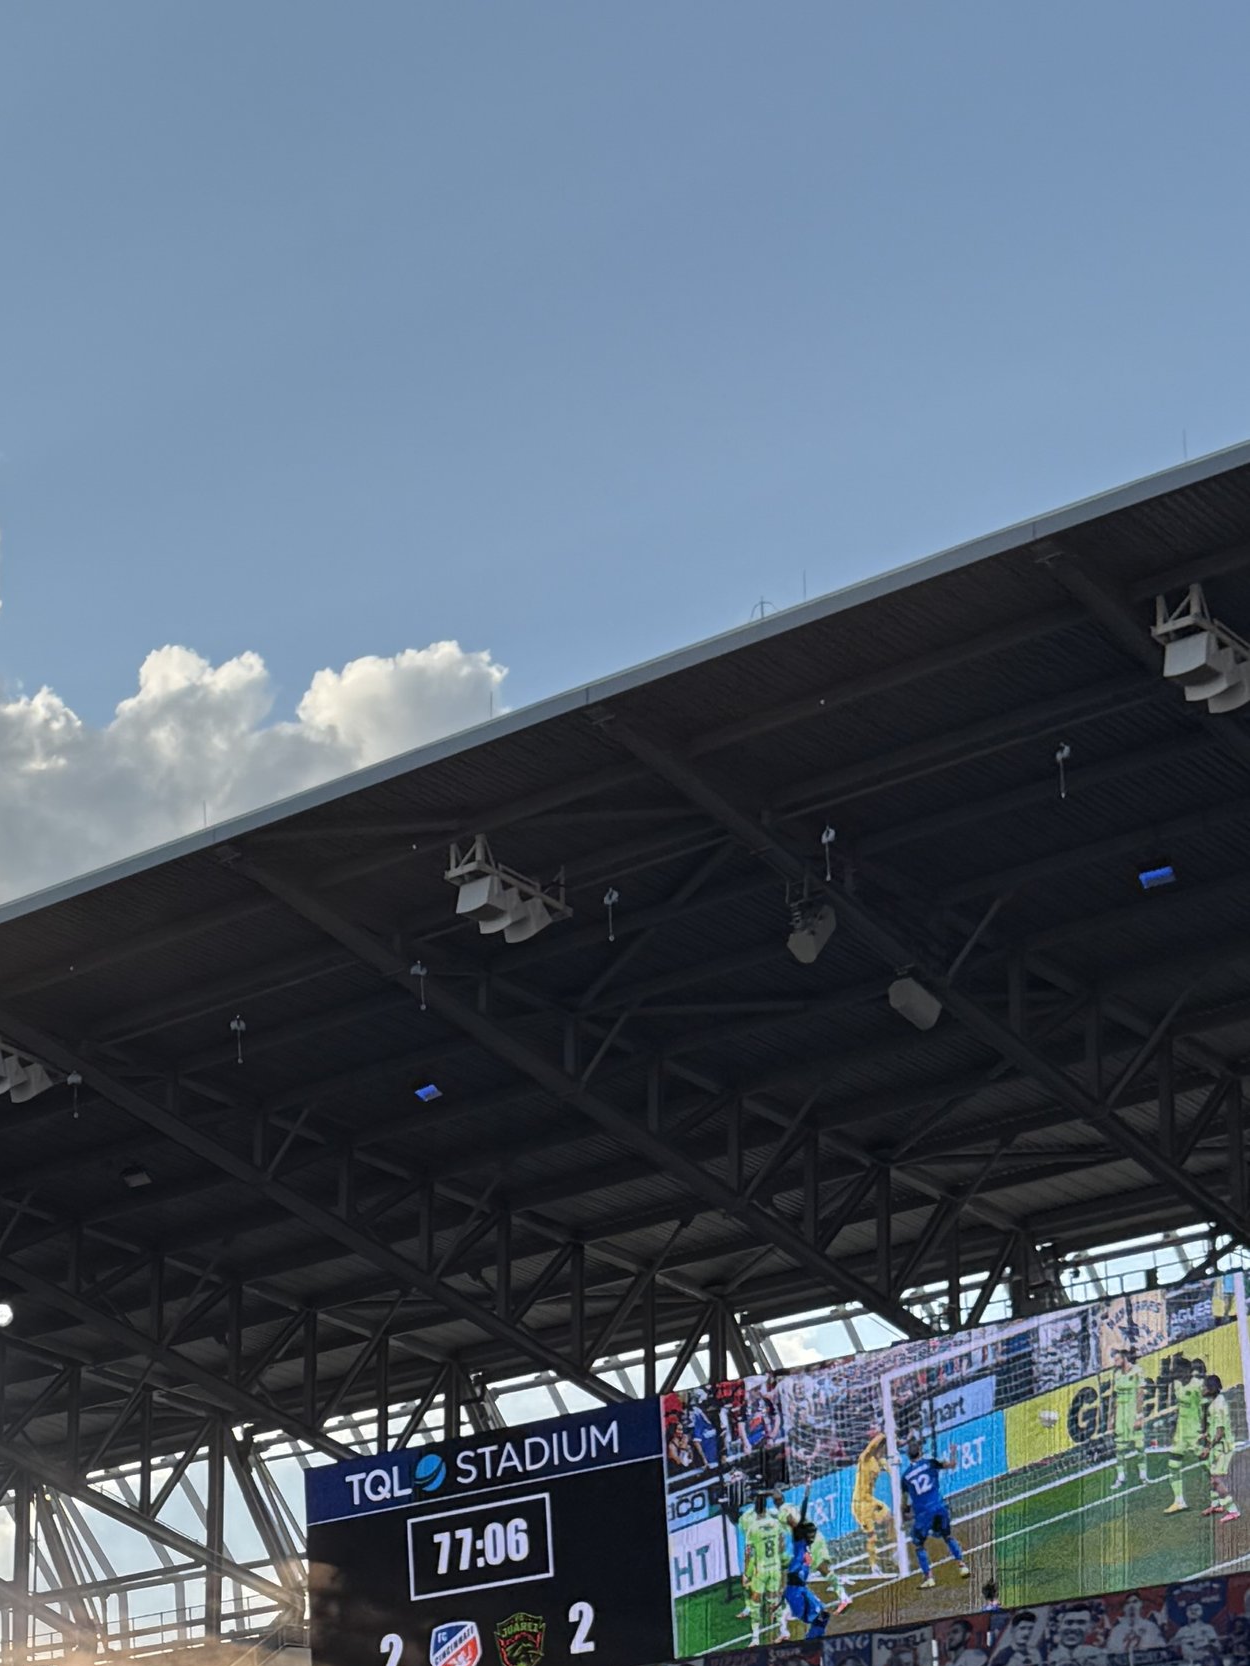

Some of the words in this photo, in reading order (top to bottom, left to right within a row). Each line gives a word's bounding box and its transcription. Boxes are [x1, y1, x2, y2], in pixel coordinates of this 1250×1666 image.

[345, 1465, 413, 1505] TQL
[456, 1420, 620, 1485] STADIUM
[910, 1474, 933, 1496] 12
[433, 1517, 529, 1575] 77:06
[673, 1545, 711, 1592] HT
[434, 1625, 476, 1666] CINCINNATI
[567, 1601, 596, 1655] 2
